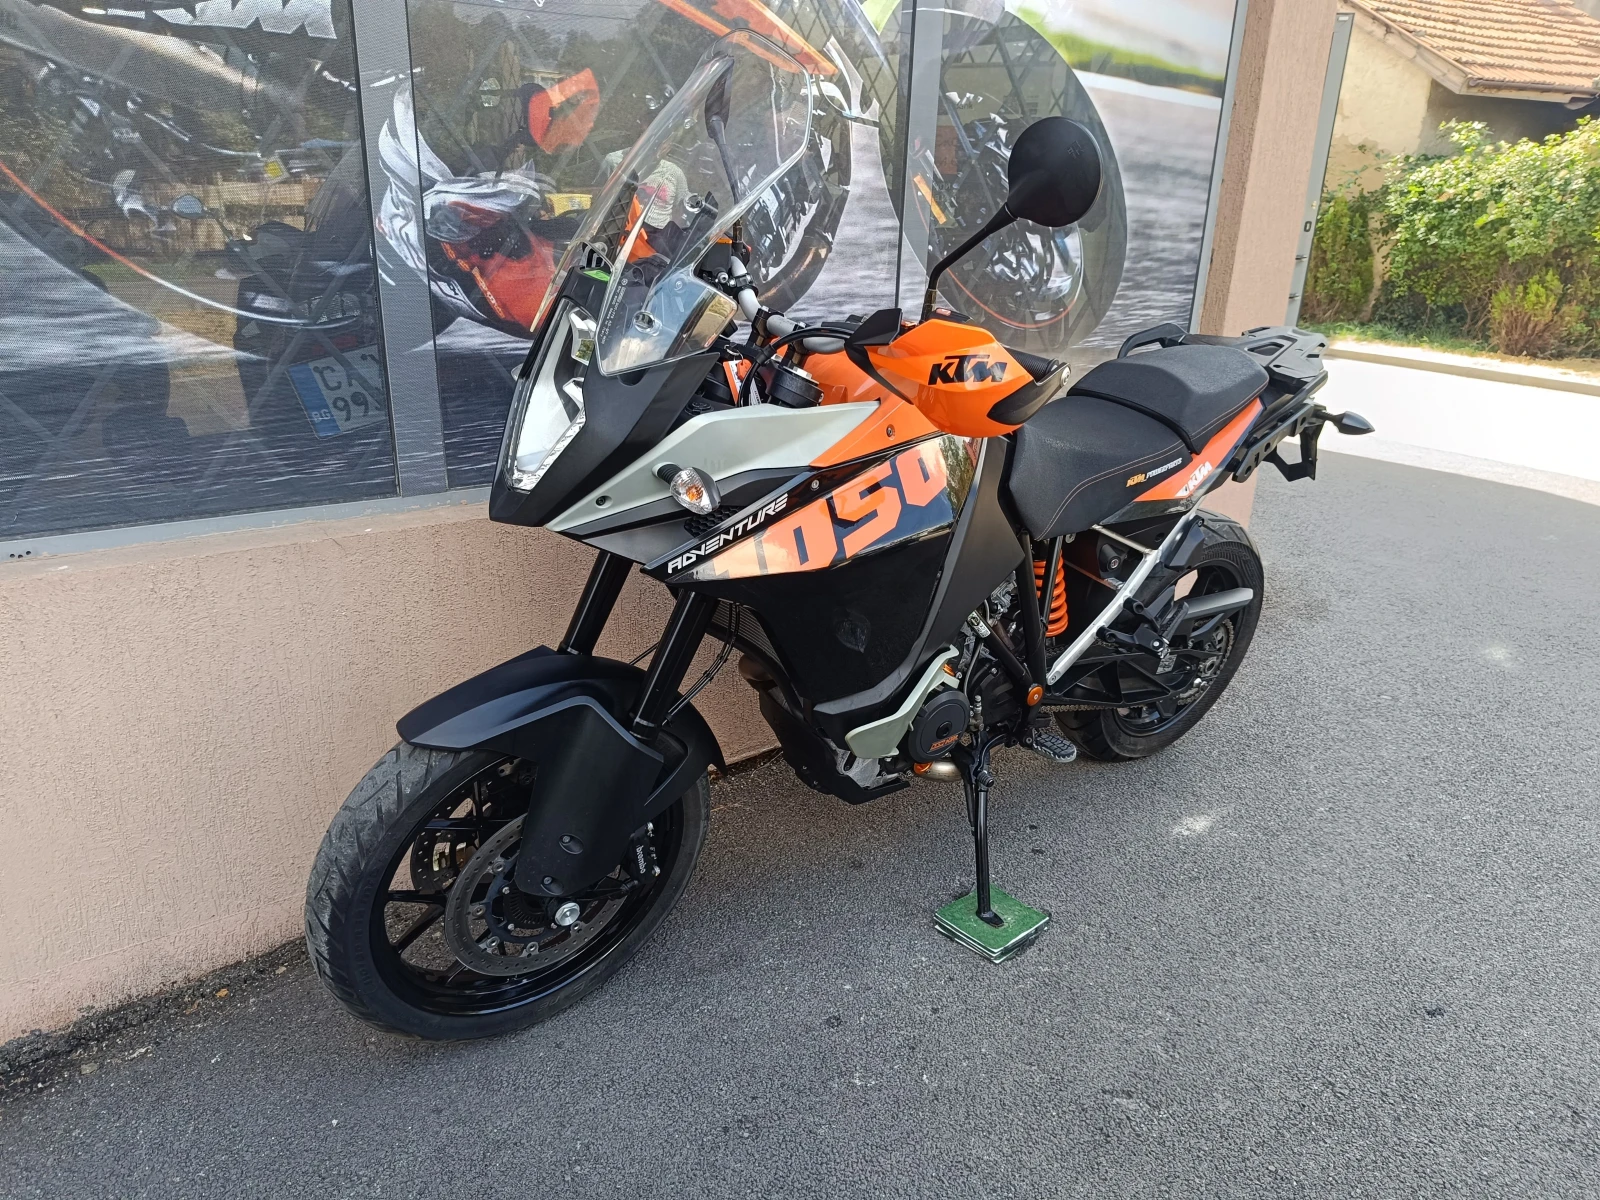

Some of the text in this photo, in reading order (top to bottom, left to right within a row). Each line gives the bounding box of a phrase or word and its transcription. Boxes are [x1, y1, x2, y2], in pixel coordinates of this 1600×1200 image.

[927, 354, 1008, 386] KTM
[1188, 461, 1213, 490] KTM
[667, 492, 788, 574] ADVENTURE
[635, 844, 647, 874] brembo
